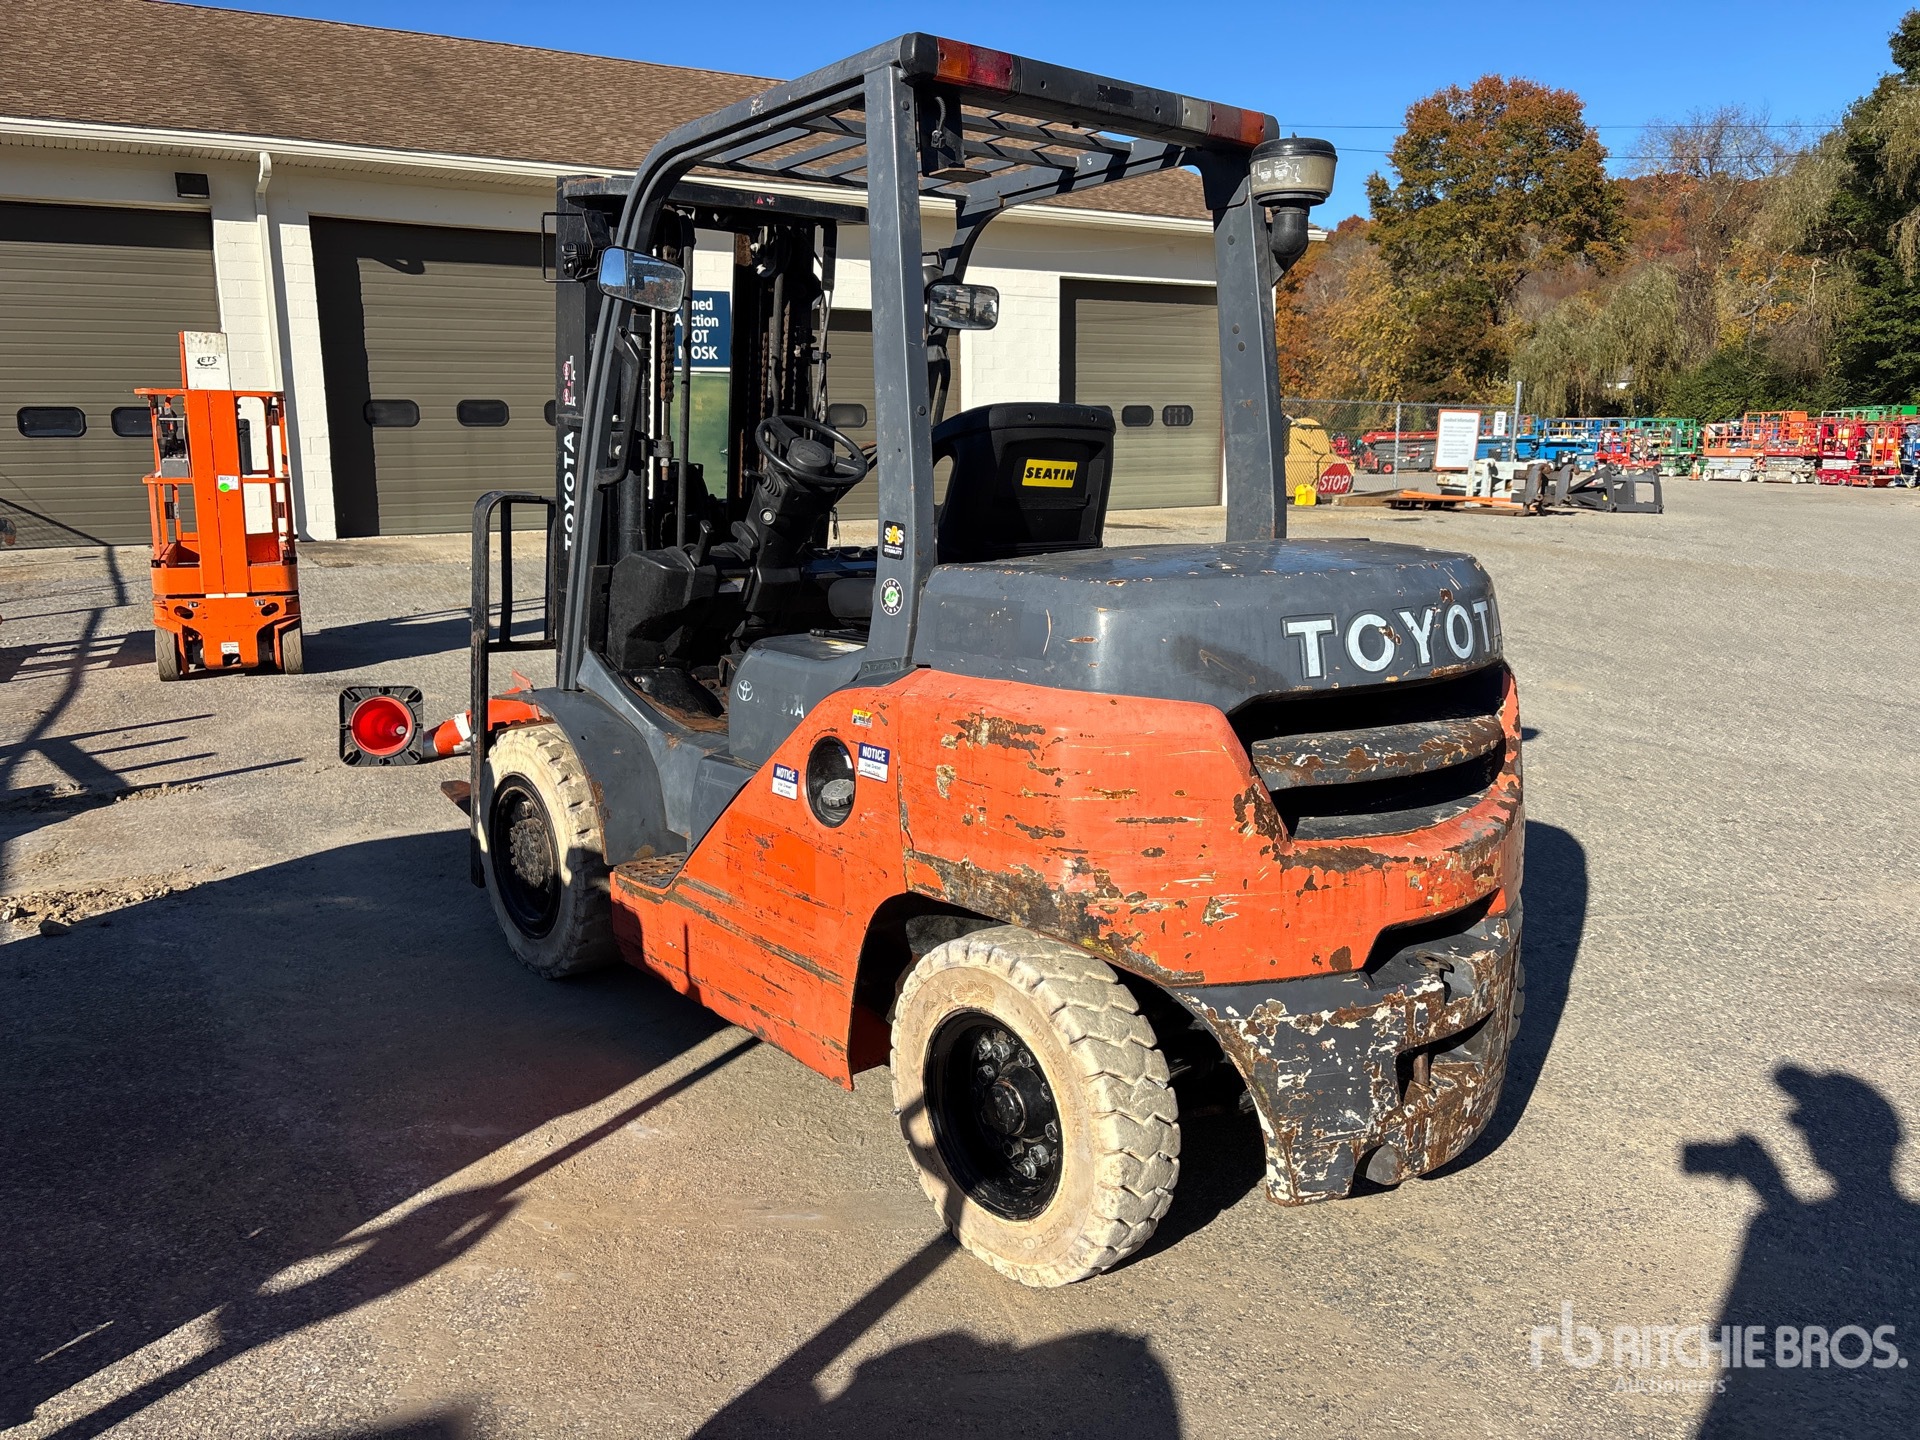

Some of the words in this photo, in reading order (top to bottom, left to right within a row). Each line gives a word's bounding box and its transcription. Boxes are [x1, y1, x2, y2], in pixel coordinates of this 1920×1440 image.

[673, 314, 719, 327] Action
[691, 330, 710, 343] OT
[1025, 466, 1075, 481] SEATIN
[564, 431, 575, 551] TOYOTA
[1320, 475, 1349, 492] STOP
[884, 525, 904, 546] SAS
[862, 745, 886, 762] NOTICE
[775, 766, 796, 782] NOTICE
